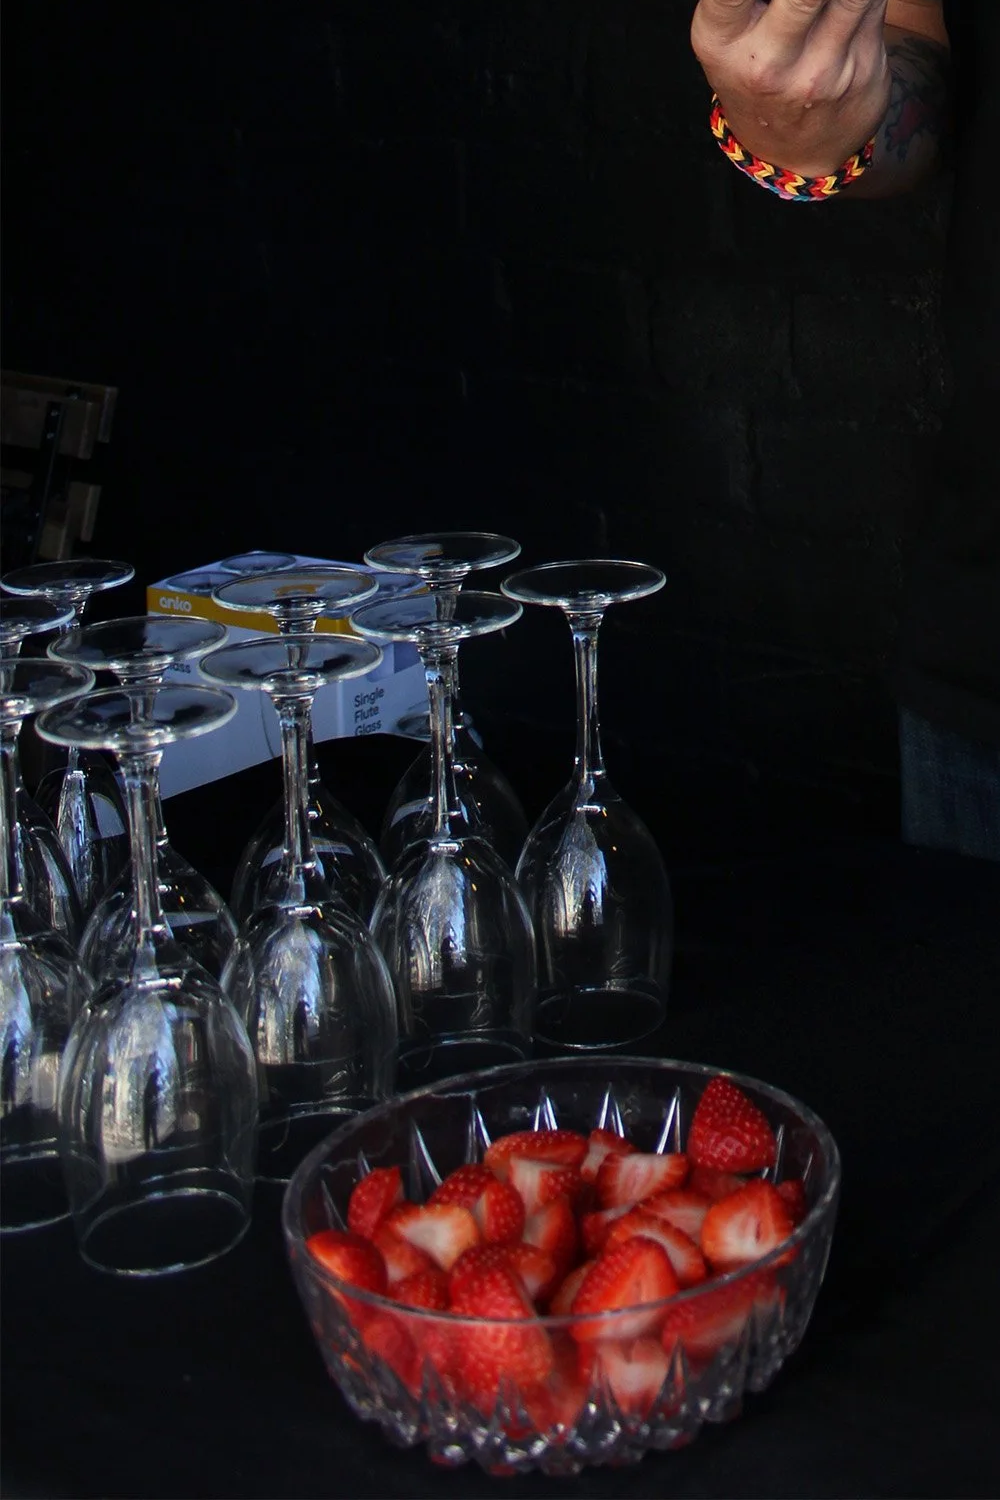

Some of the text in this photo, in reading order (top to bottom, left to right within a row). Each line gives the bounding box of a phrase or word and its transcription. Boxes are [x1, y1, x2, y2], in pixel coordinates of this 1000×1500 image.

[159, 595, 192, 613] anko
[354, 687, 385, 708] Single
[354, 706, 380, 723] Flute
[354, 719, 382, 737] Glass
